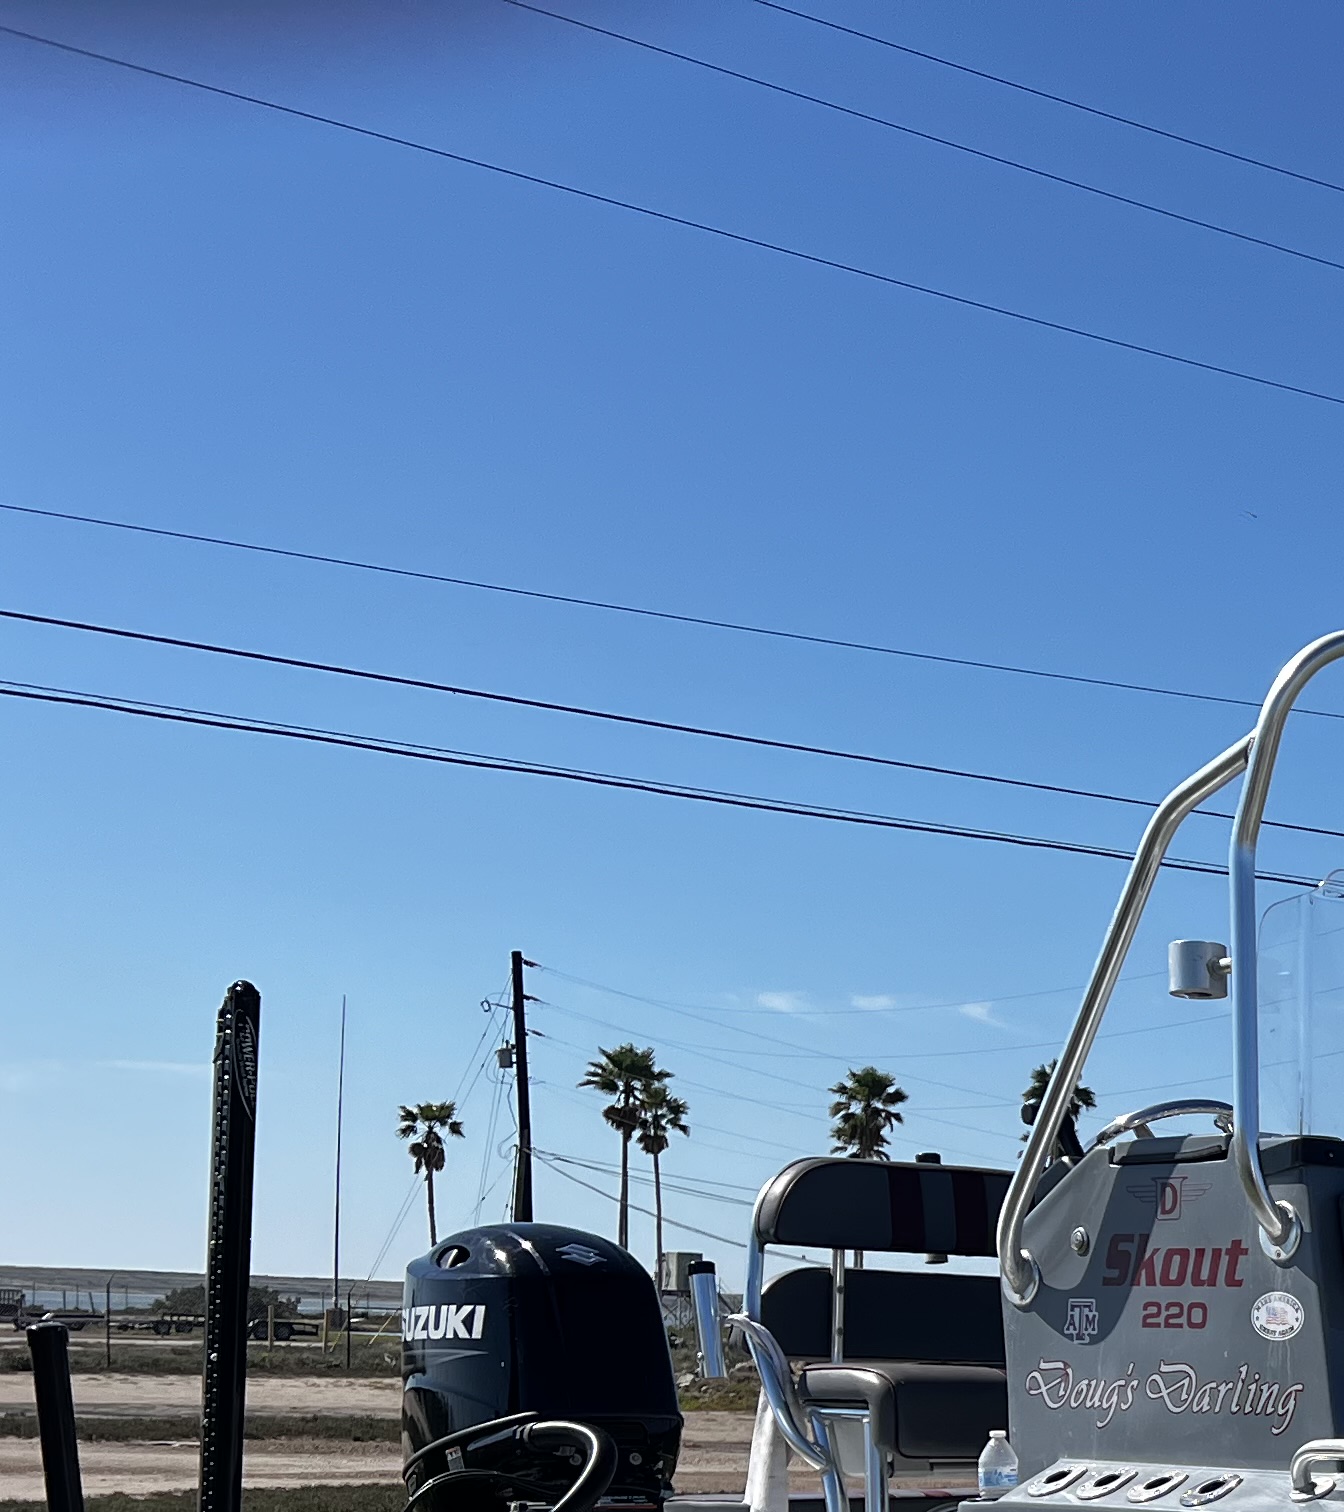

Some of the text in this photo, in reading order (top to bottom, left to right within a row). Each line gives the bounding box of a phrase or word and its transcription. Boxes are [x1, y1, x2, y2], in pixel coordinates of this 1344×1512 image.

[1101, 1233, 1249, 1288] Skout
[1142, 1301, 1208, 1330] 220
[1025, 1357, 1304, 1436] Doug's Darling
